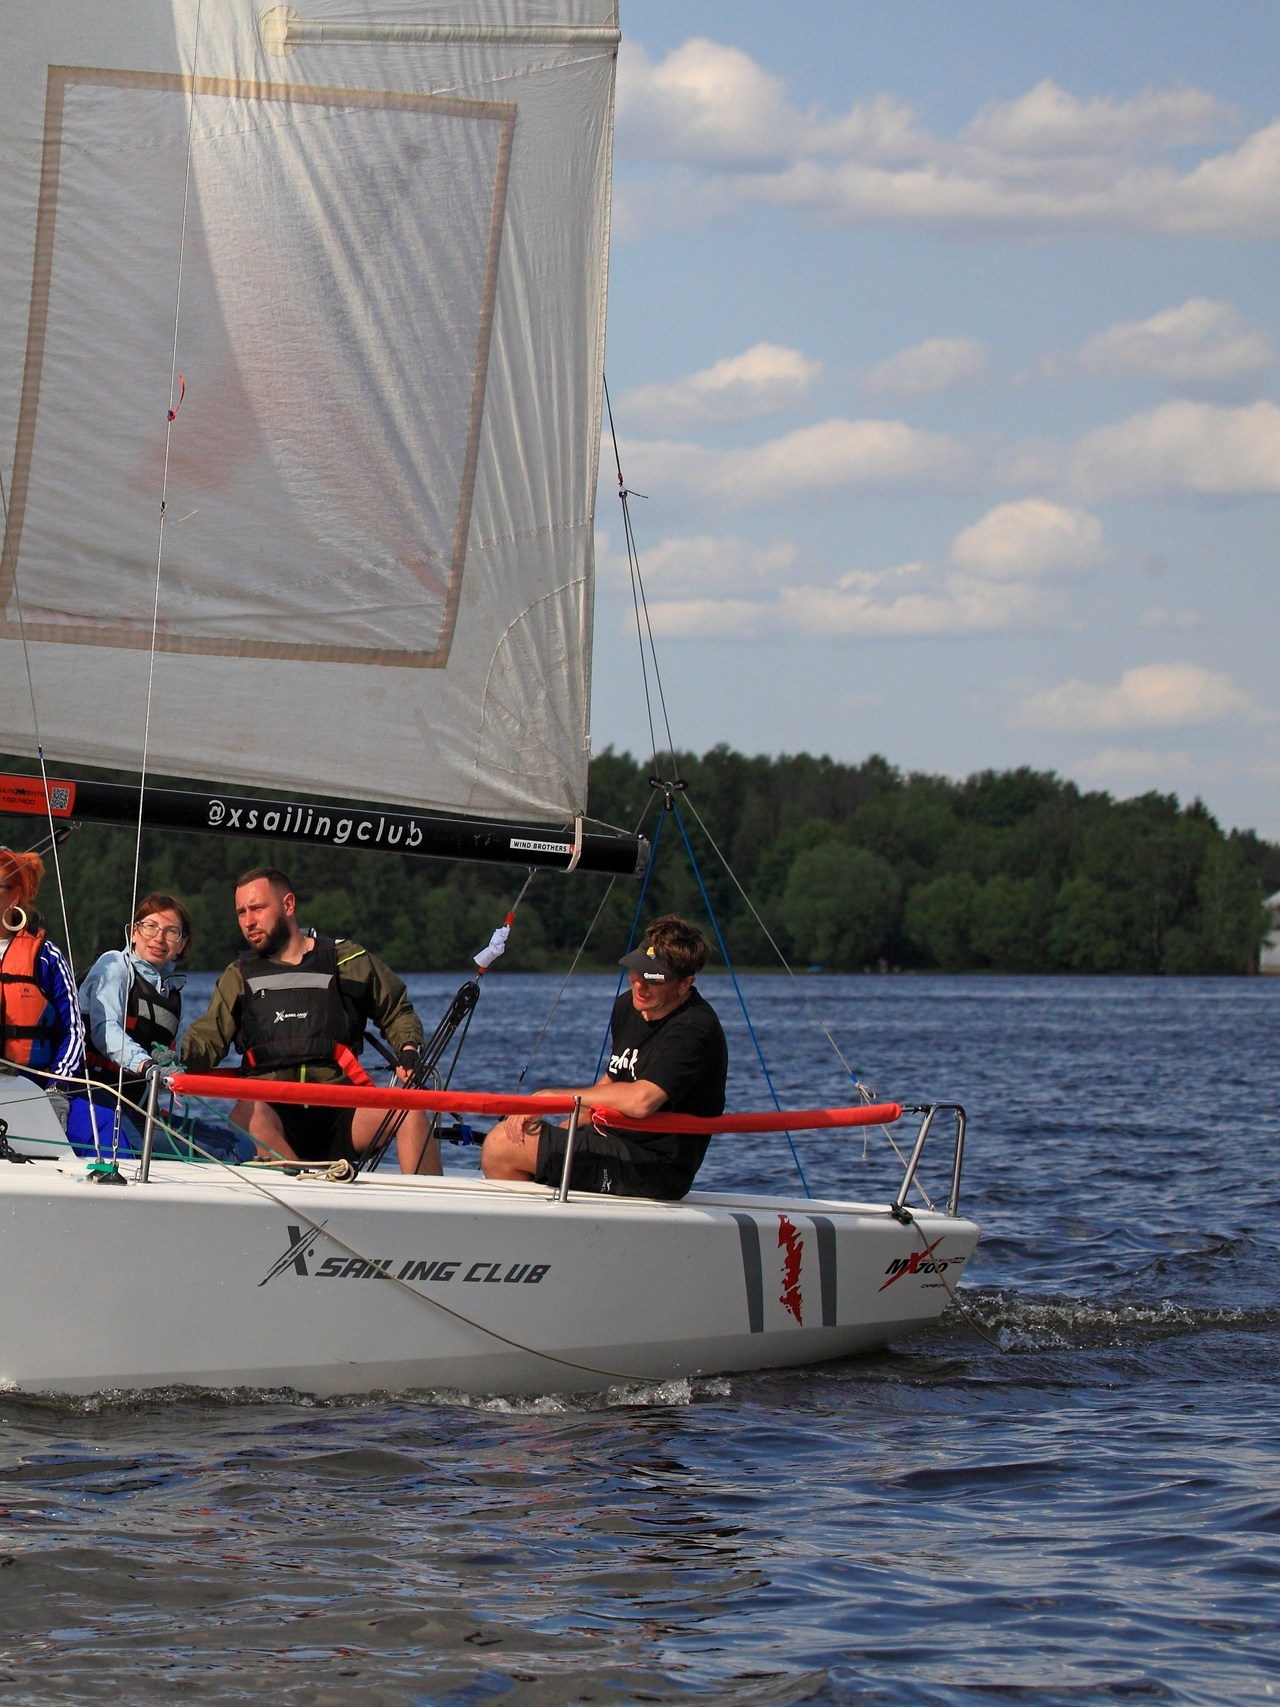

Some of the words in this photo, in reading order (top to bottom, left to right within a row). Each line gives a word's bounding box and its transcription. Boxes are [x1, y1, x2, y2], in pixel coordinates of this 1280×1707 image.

[208, 799, 423, 846] @xsailingclub
[533, 843, 567, 852] BROTHERS
[315, 1257, 462, 1282] SAILING
[463, 1262, 552, 1284] CLUB
